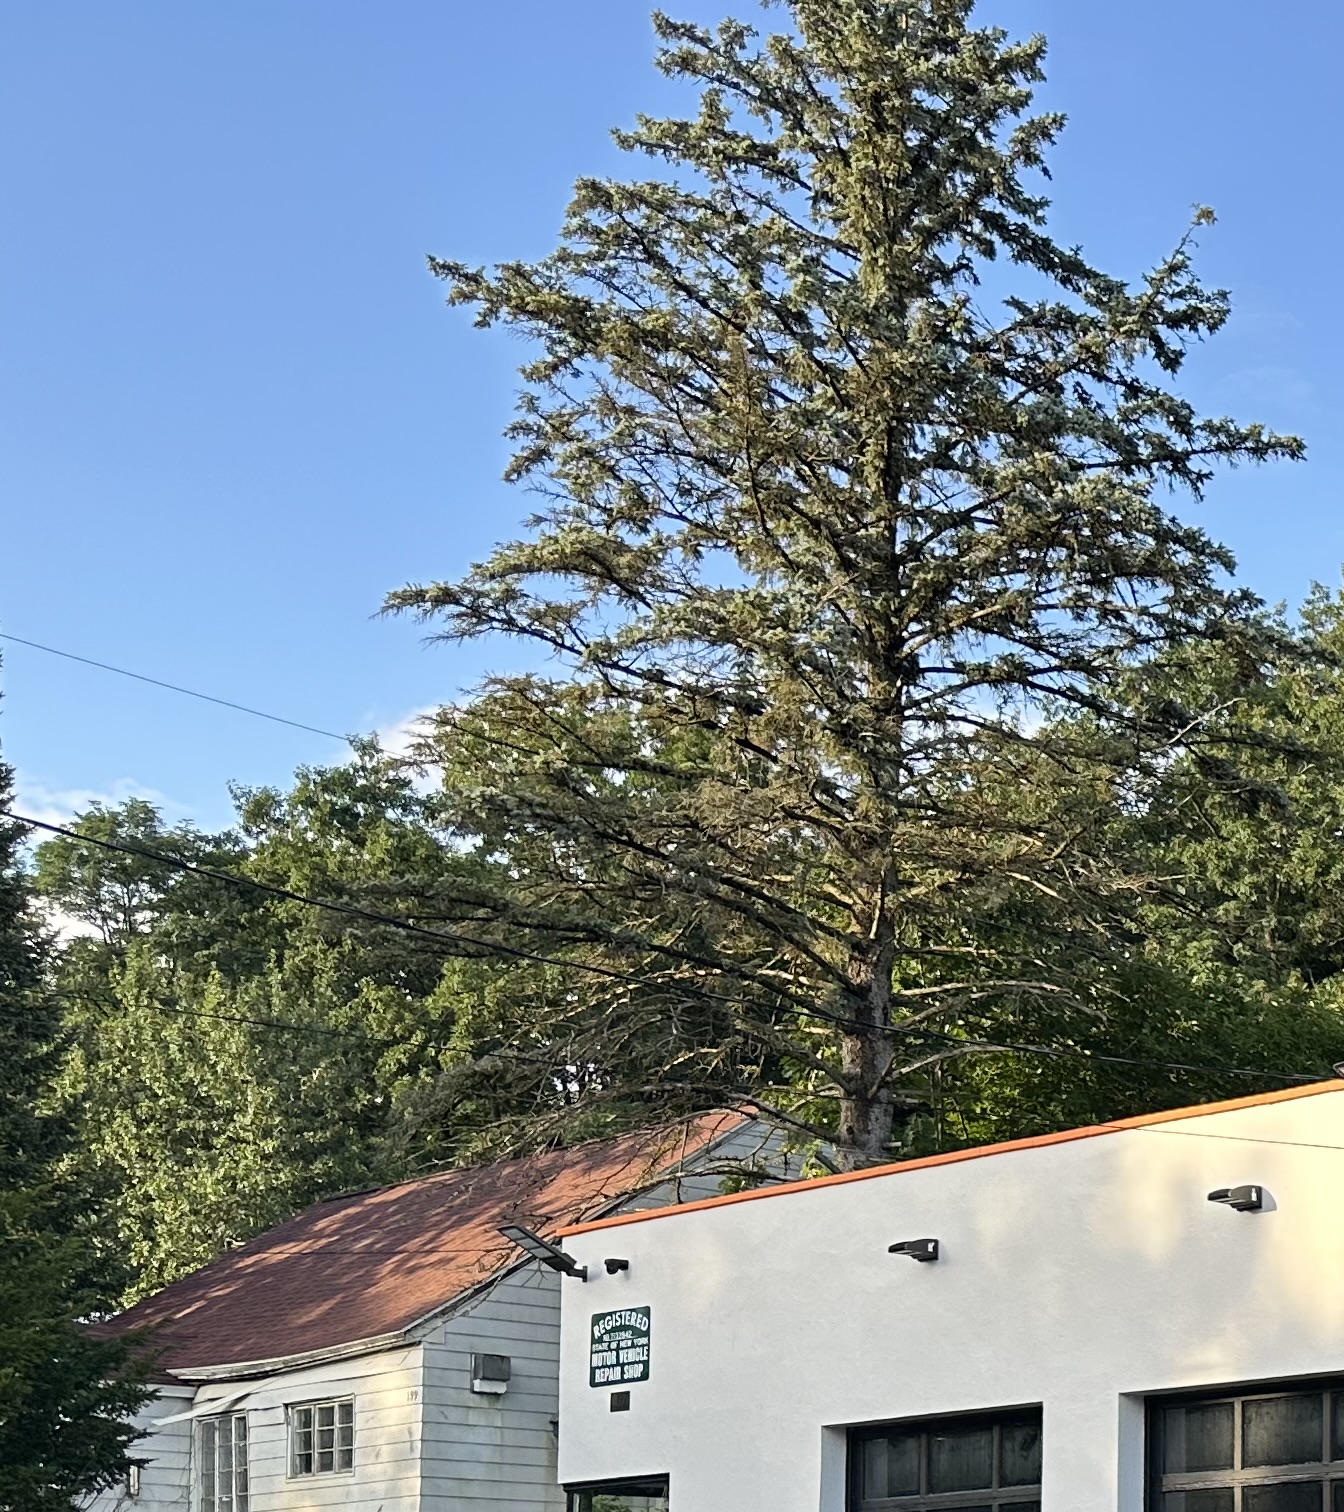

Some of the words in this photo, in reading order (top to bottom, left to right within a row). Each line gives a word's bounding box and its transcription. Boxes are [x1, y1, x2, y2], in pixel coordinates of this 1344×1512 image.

[593, 1311, 649, 1339] REGISTERED
[592, 1350, 617, 1367] MOTOR
[619, 1346, 648, 1363] VEHICLE
[595, 1366, 621, 1383] REPAIR
[623, 1363, 643, 1380] SHOP
